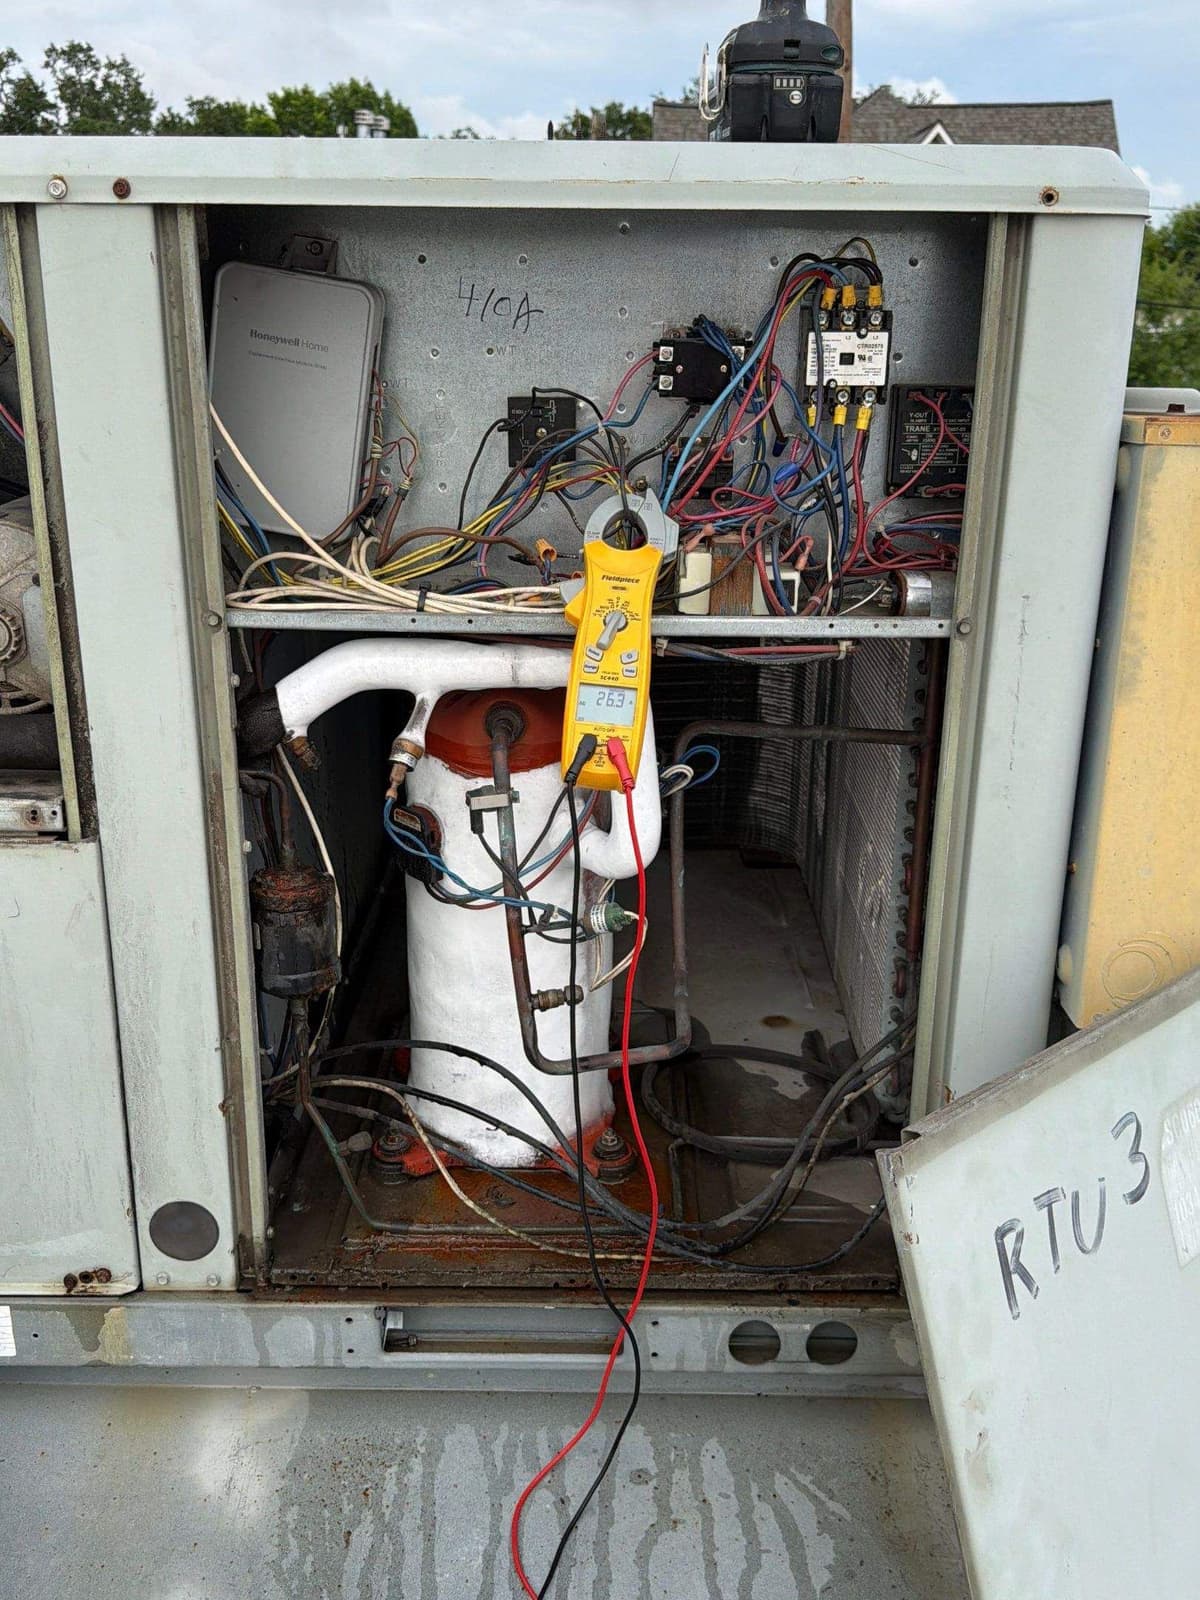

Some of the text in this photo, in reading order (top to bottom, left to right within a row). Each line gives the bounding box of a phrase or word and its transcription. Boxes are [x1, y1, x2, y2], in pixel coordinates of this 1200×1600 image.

[458, 276, 544, 334] 410A
[249, 328, 329, 353] Honeywell Home
[905, 425, 931, 433] TRANE
[601, 574, 641, 584] Fieldpiece
[994, 1111, 1151, 1320] RTU 3
